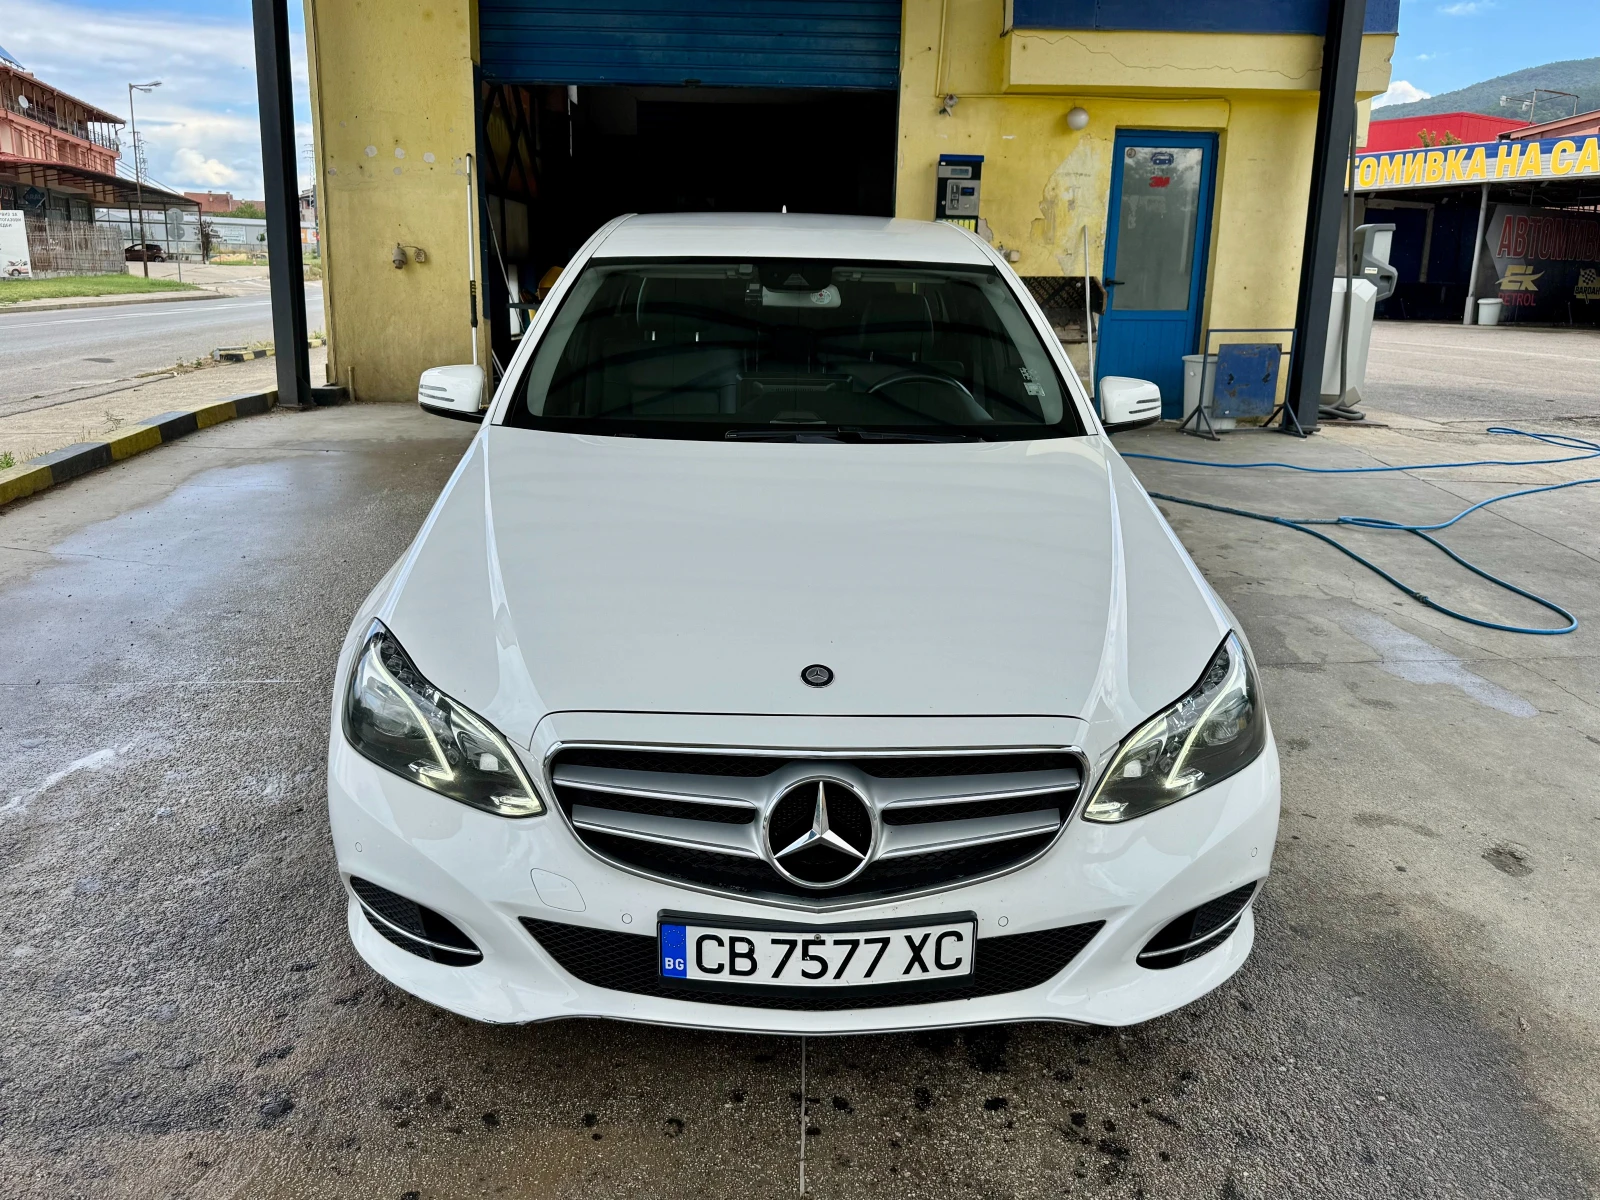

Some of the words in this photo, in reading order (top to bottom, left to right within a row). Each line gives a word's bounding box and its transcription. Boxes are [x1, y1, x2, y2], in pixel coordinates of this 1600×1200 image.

[1494, 142, 1542, 179] НА
[1550, 137, 1600, 175] СА
[1148, 175, 1171, 188] 3M
[1496, 214, 1600, 262] АВТОМИВ
[664, 957, 685, 971] BG
[695, 933, 758, 976] CB
[770, 937, 891, 980] 7577
[902, 930, 964, 975] XC
